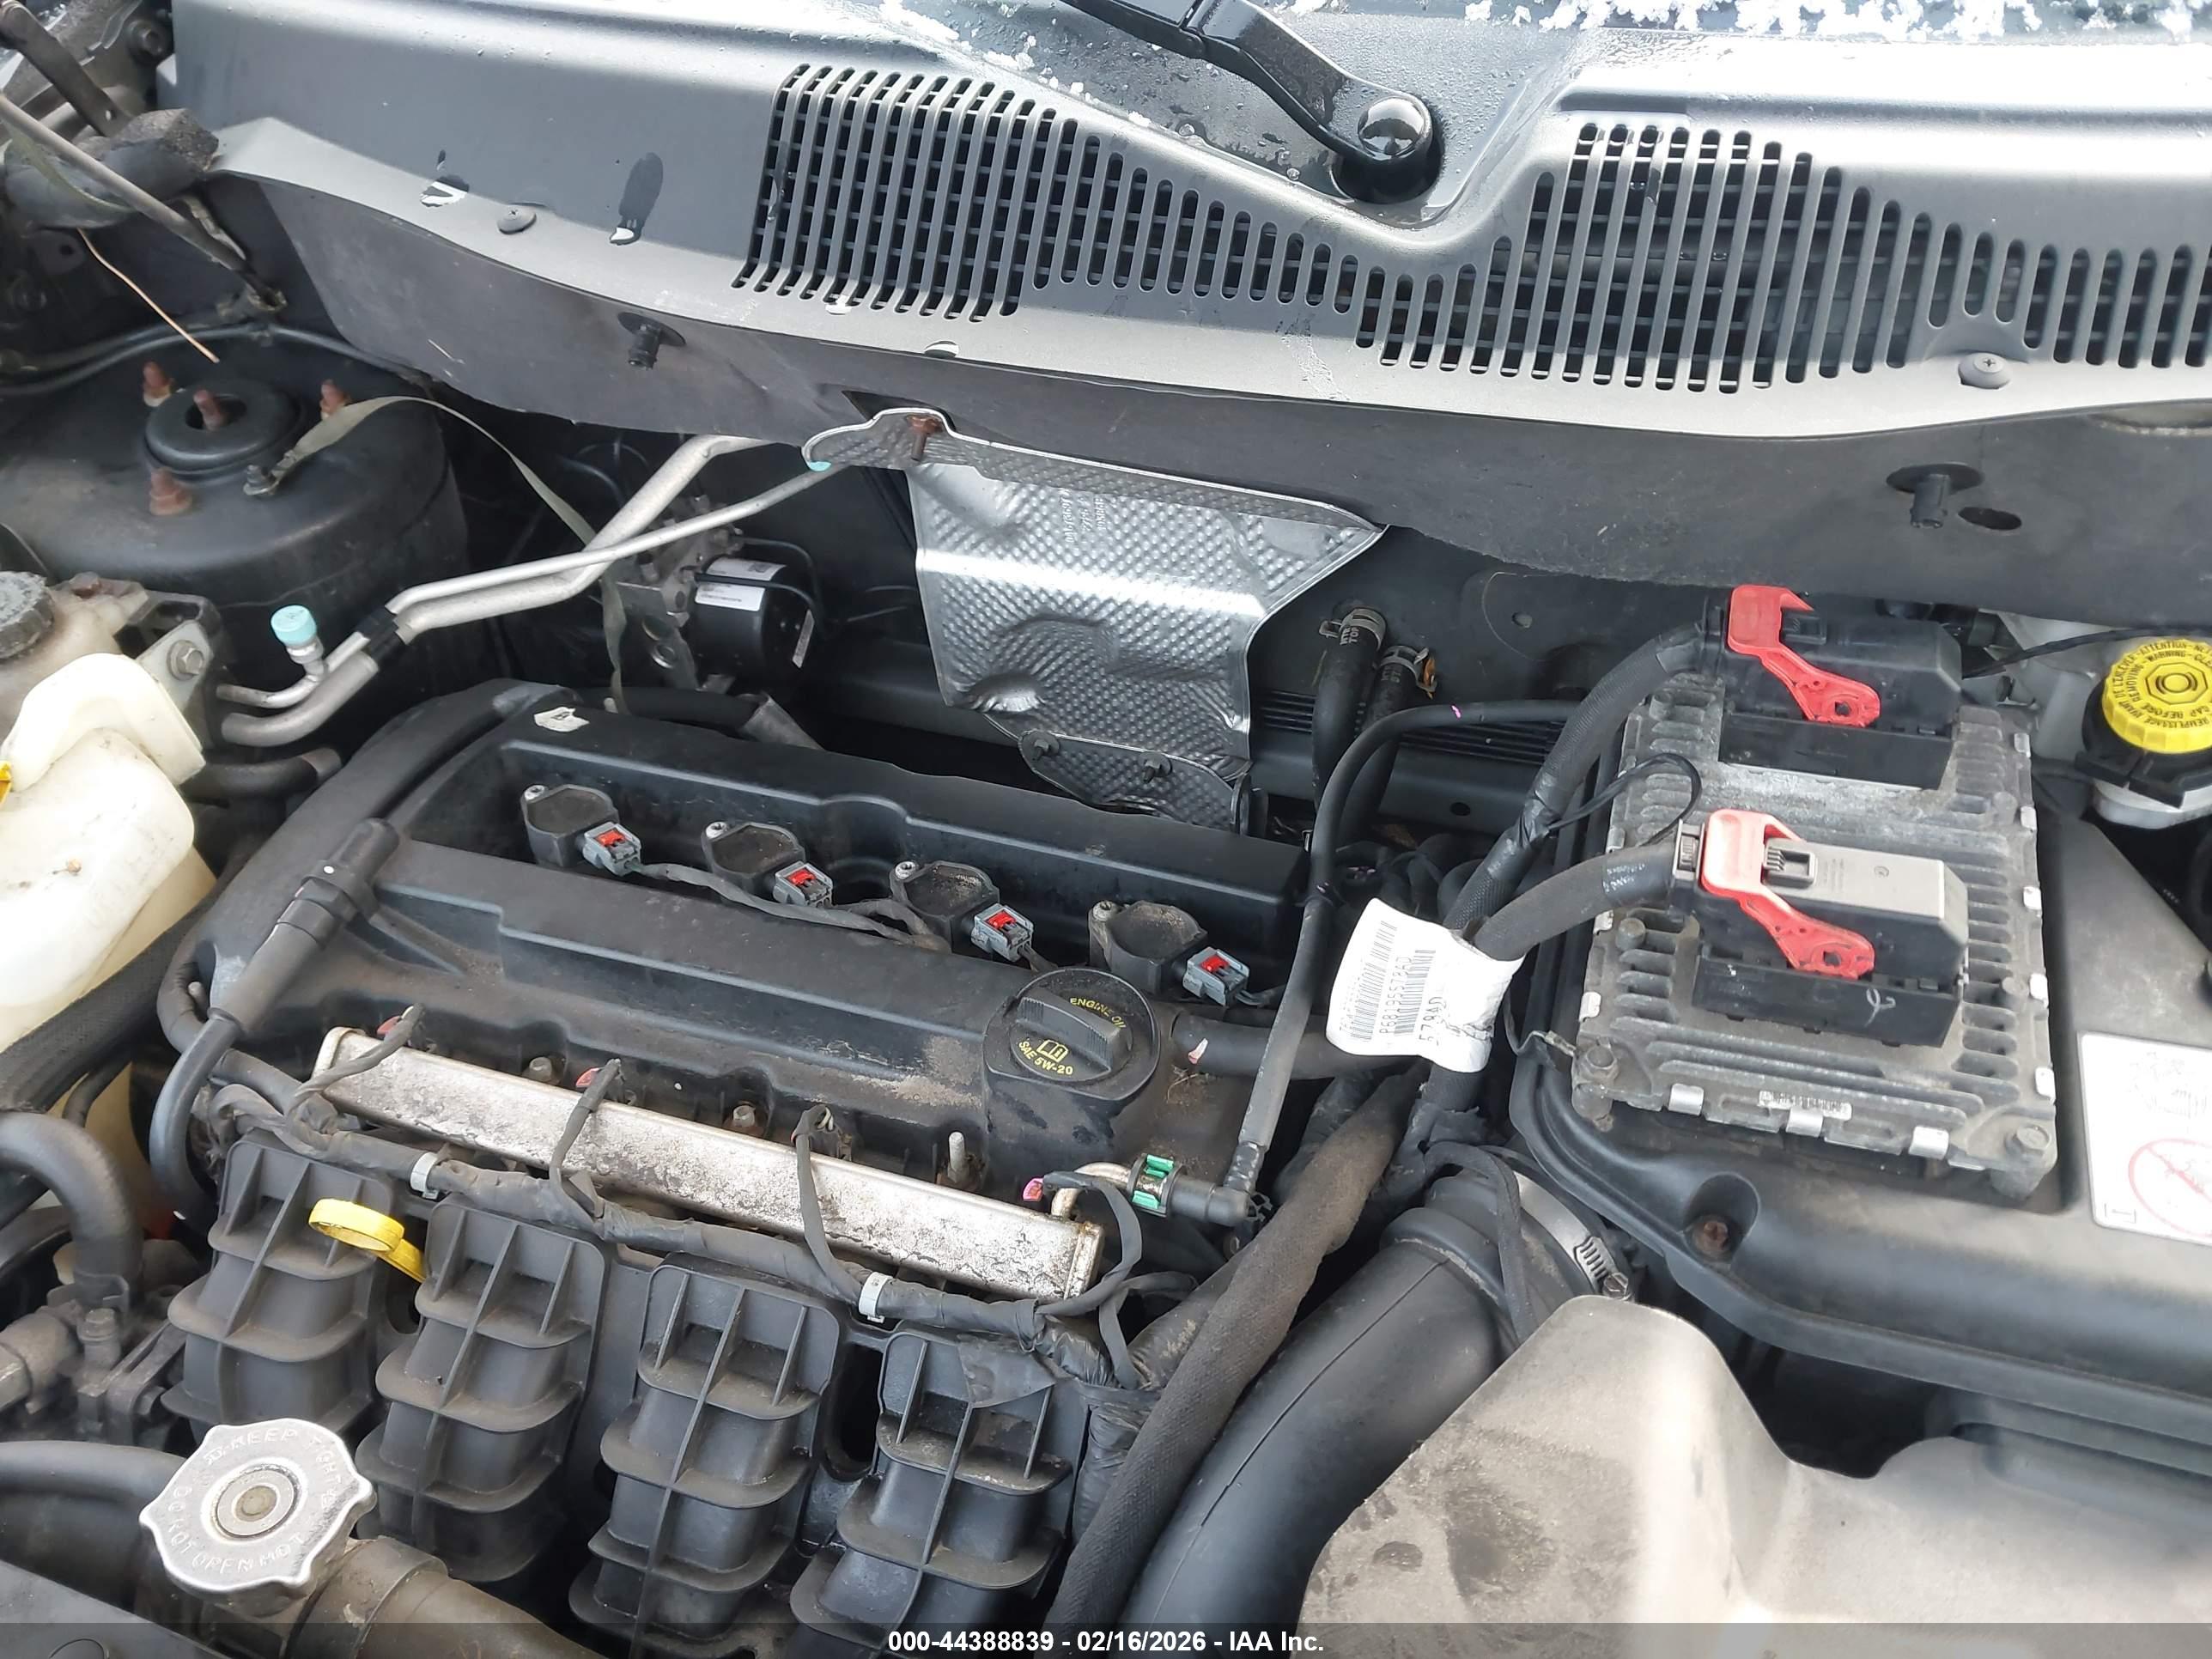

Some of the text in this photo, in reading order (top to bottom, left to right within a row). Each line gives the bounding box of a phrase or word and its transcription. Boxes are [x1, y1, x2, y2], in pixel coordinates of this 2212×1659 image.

[2146, 650, 2186, 662] WARNING
[2125, 664, 2144, 702] REMOVING
[2141, 703, 2184, 719] BEFORE
[1018, 1041, 1073, 1075] SAE 5W-20
